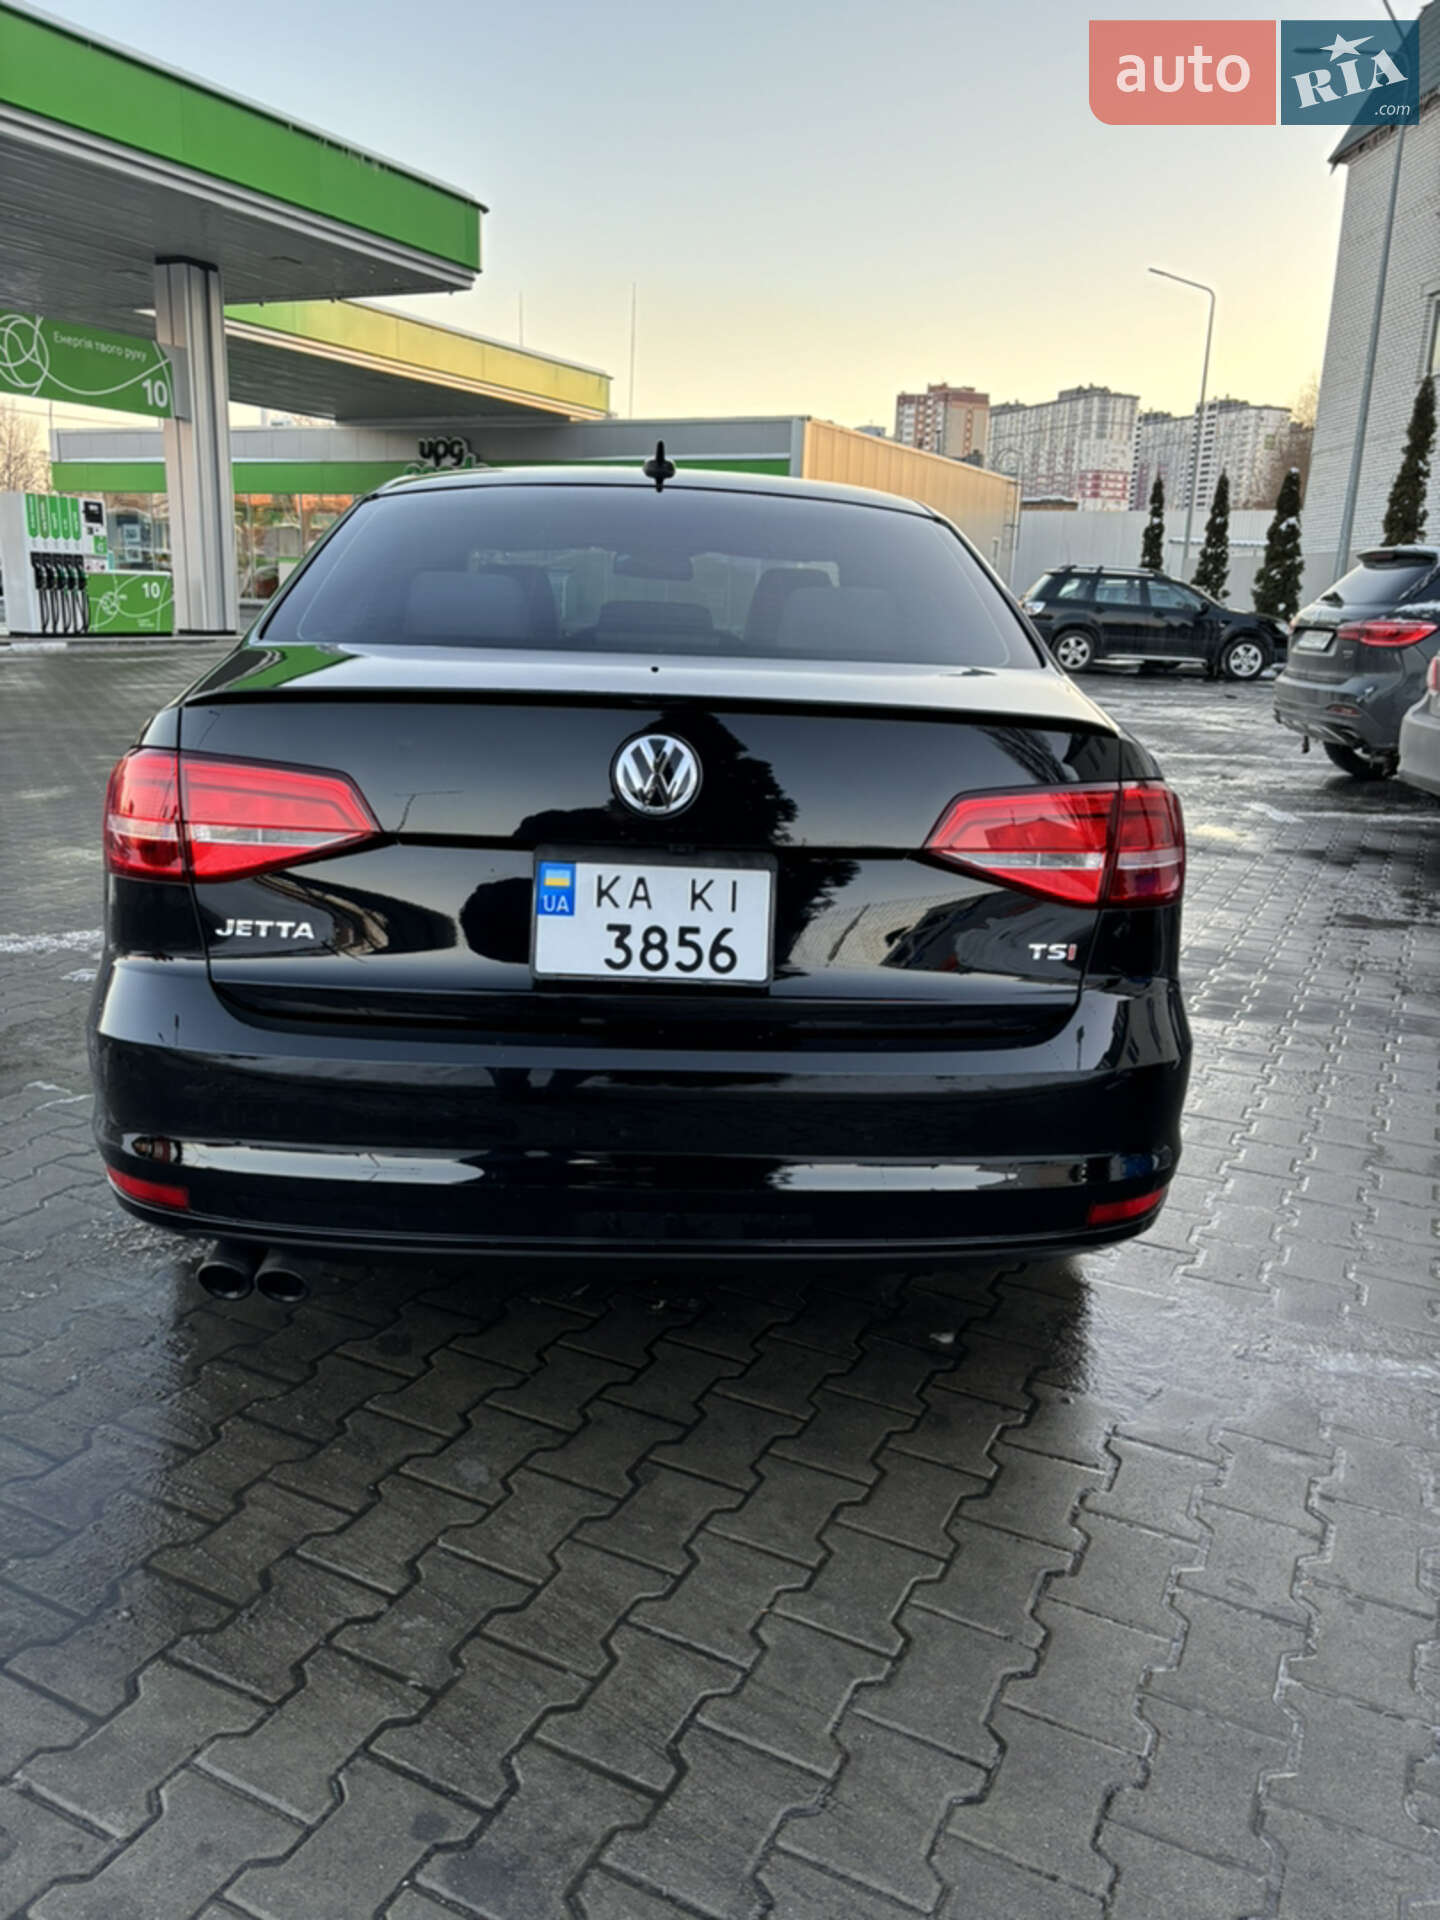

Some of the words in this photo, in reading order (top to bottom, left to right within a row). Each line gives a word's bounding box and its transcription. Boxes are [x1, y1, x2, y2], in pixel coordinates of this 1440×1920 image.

[53, 330, 94, 350] Енергія
[142, 378, 168, 408] 10
[418, 440, 464, 468] upg
[141, 582, 161, 599] 10
[543, 895, 570, 913] UA
[596, 874, 652, 910] KA
[690, 878, 738, 913] KI
[214, 918, 315, 940] JETTA
[604, 923, 738, 974] 3856
[1028, 943, 1078, 961] TSI
